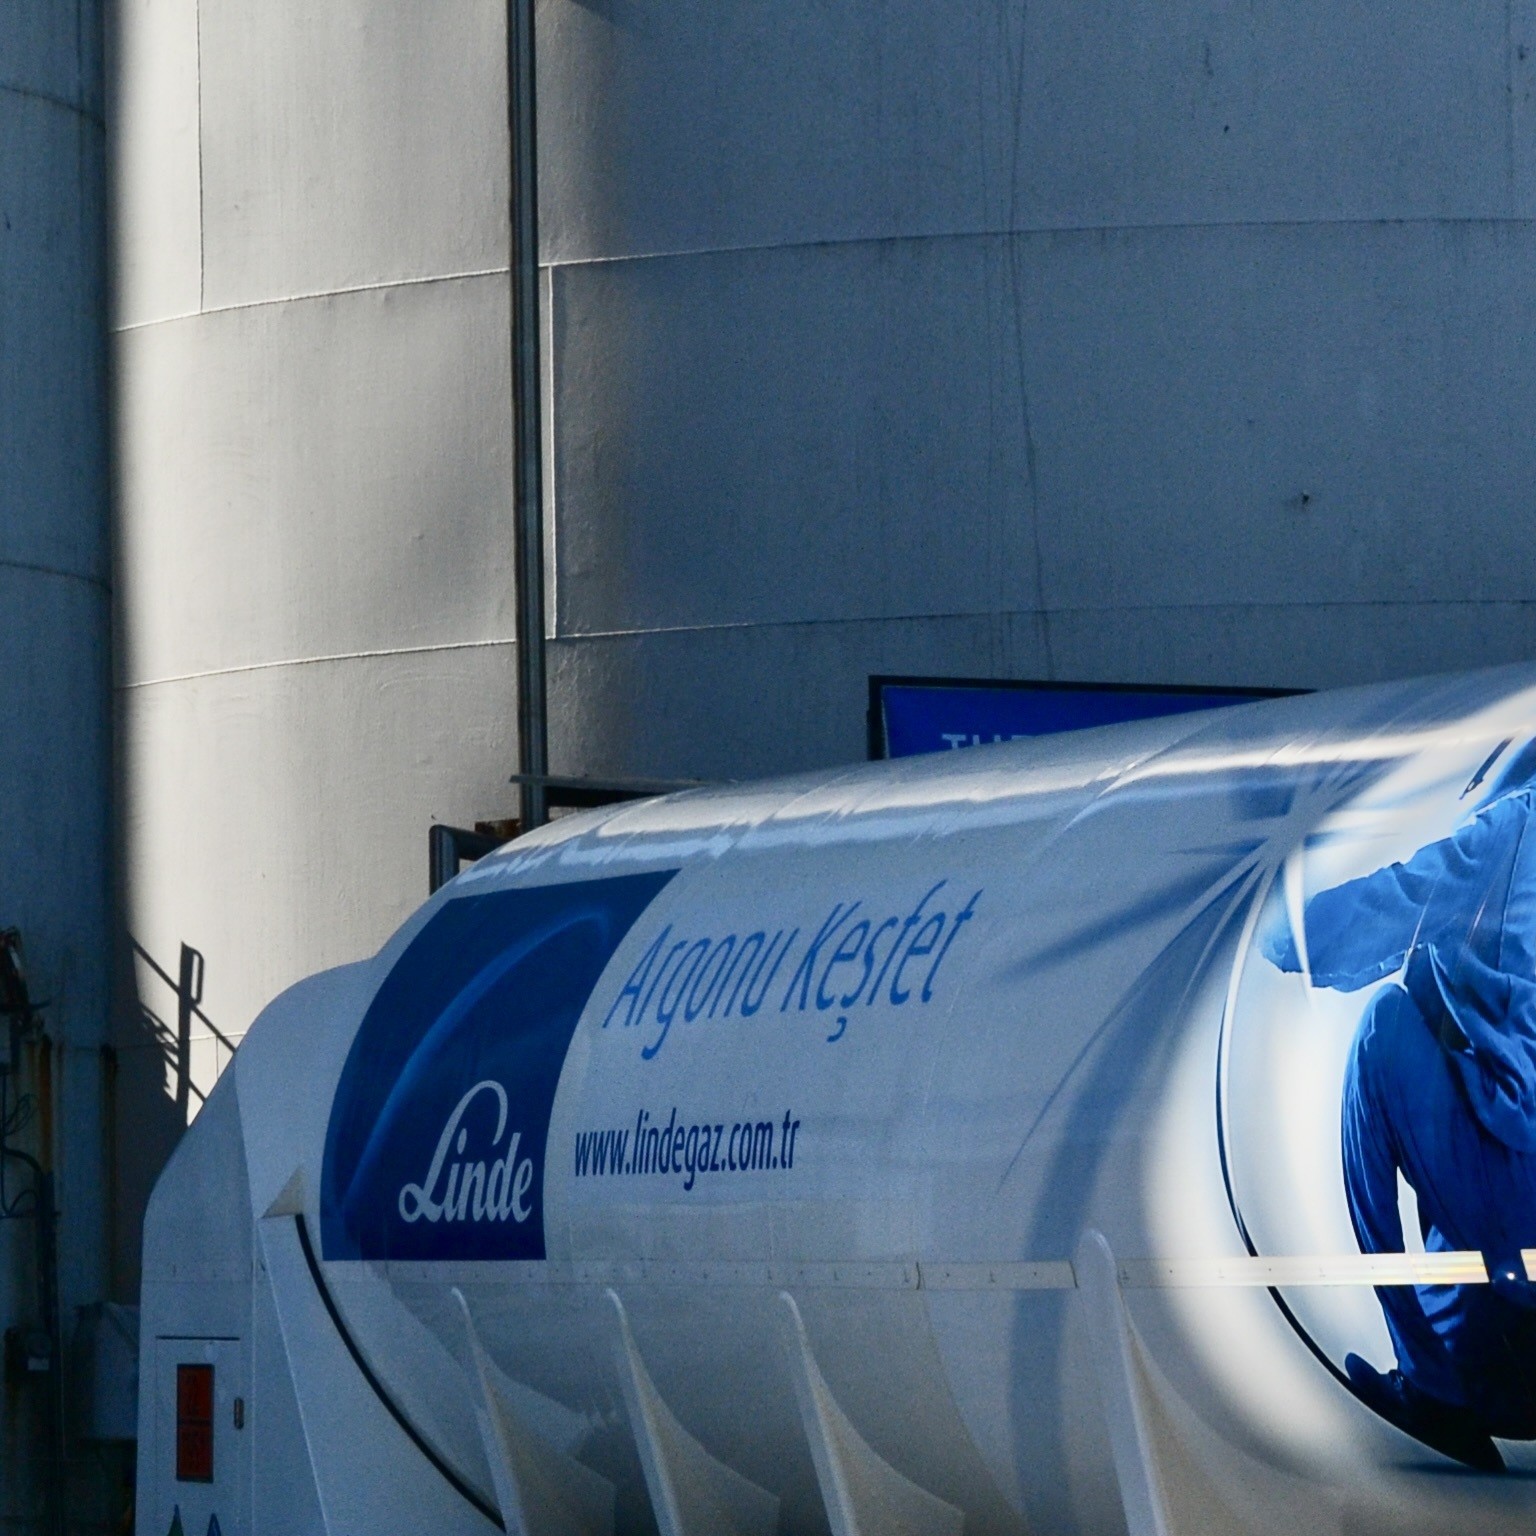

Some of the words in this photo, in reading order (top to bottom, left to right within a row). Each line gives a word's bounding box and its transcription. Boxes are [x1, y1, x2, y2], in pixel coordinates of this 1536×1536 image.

[602, 924, 800, 1060] Argonu
[780, 879, 984, 1042] Keşfet
[399, 1080, 533, 1223] Linde
[575, 1107, 801, 1191] www.lindegaz.com.tr
